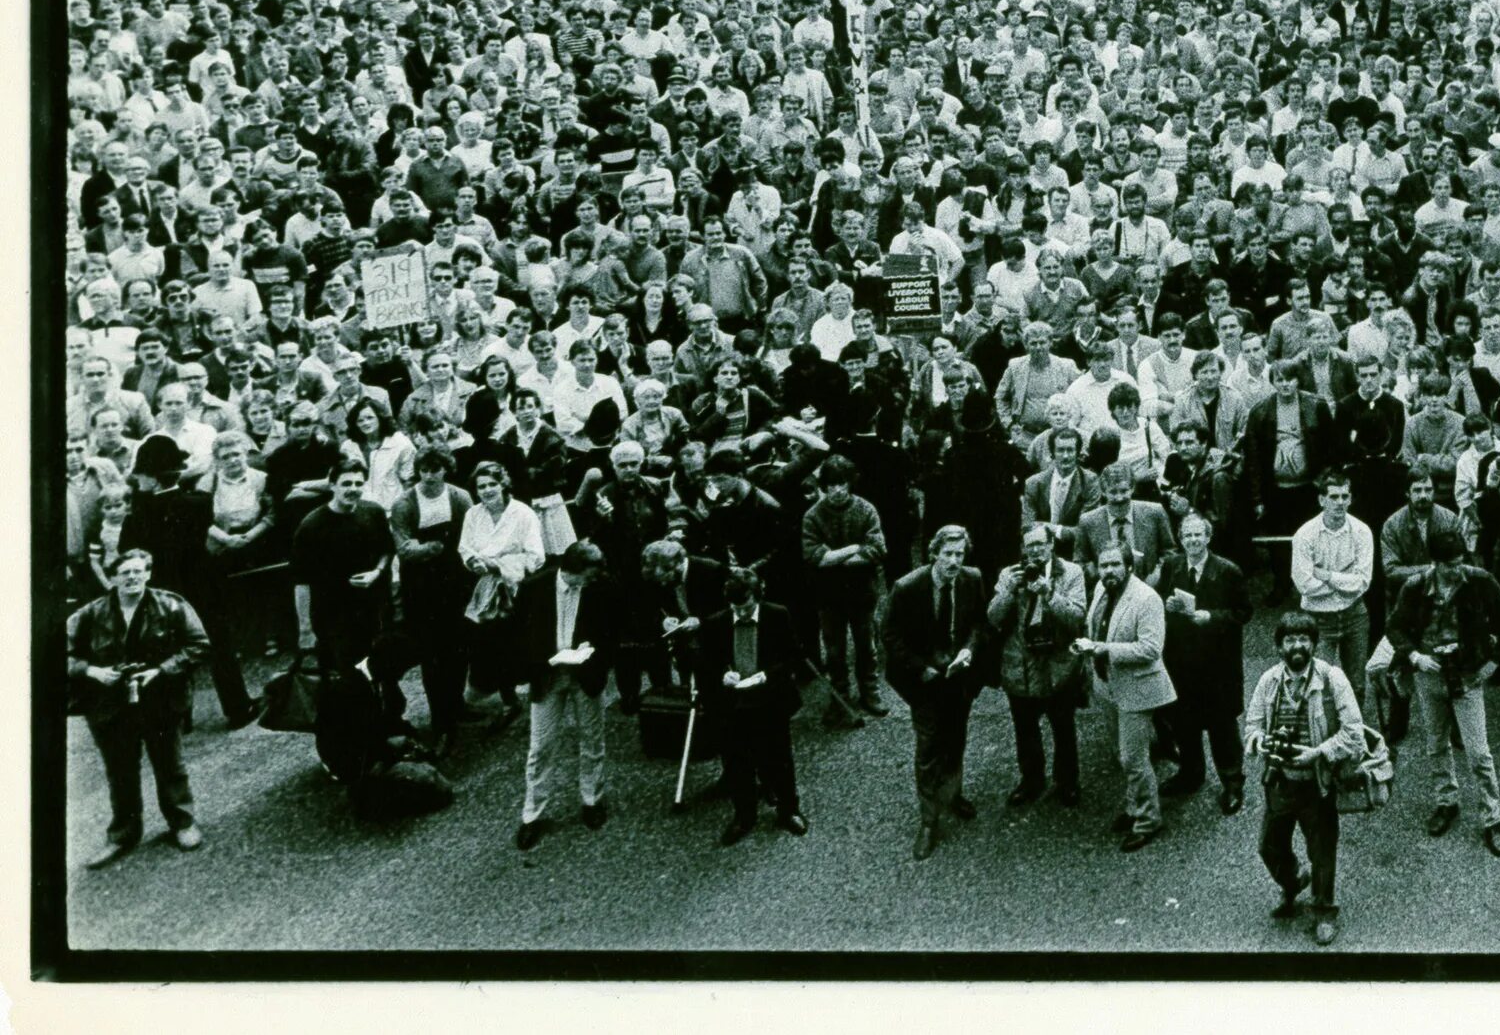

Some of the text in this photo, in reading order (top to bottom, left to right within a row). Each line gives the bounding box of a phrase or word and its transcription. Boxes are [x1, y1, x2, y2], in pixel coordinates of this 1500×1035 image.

[372, 258, 412, 287] 319
[891, 280, 931, 290] SUPPORT
[366, 283, 410, 305] TAXI
[887, 288, 935, 298] LIVERPOOL
[895, 296, 930, 305] LABOUR
[894, 303, 932, 312] COUNCIL
